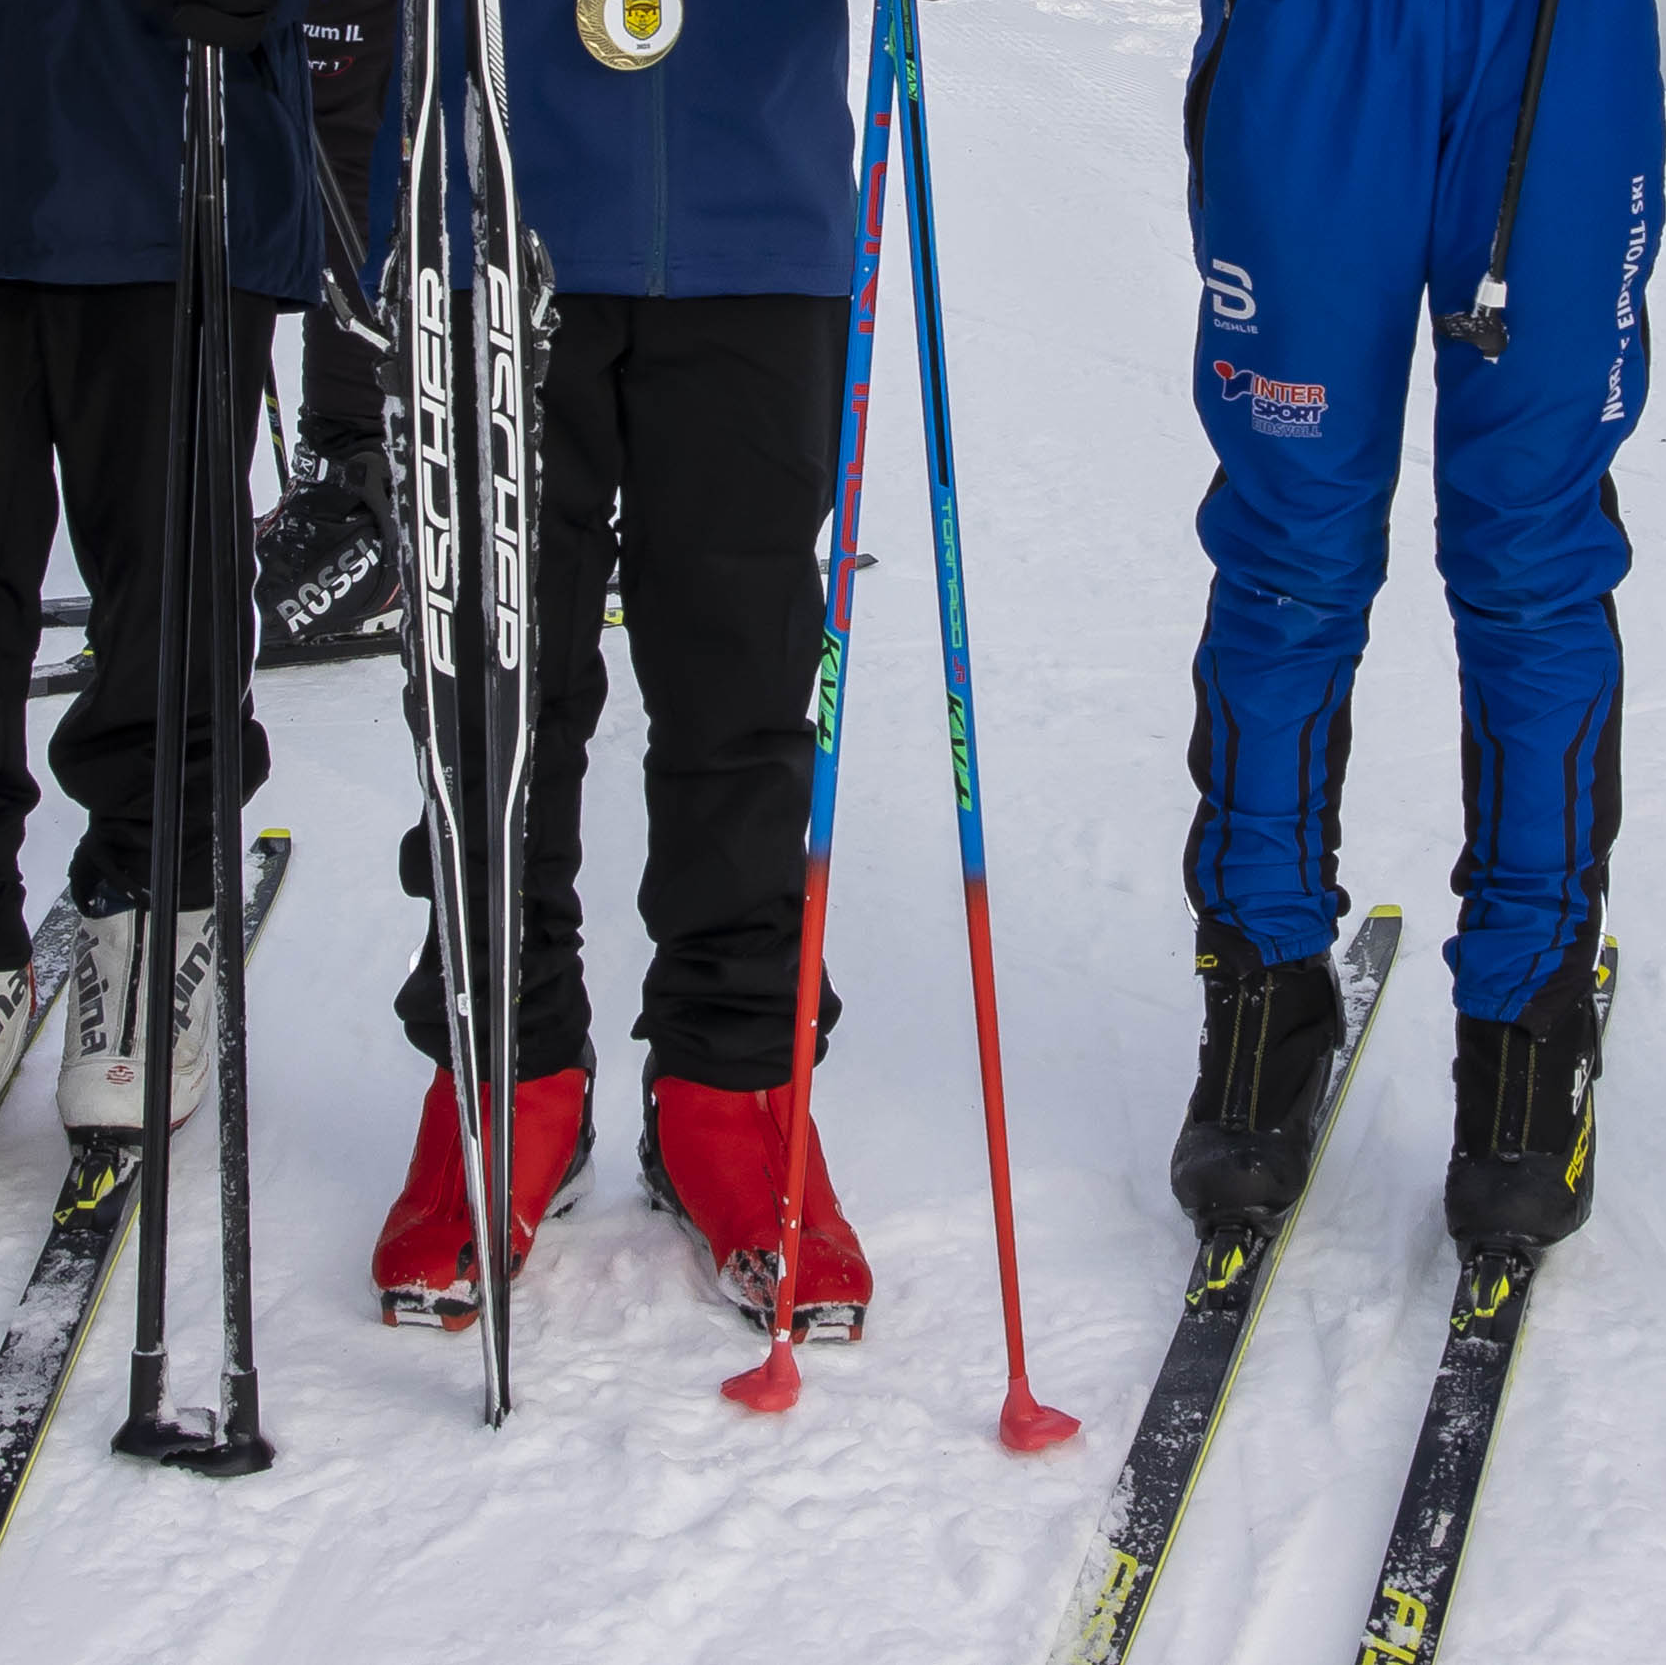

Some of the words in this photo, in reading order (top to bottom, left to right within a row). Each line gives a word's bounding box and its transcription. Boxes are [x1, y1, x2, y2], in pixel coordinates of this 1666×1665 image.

[302, 23, 340, 41] rum
[345, 24, 364, 42] IL
[1631, 175, 1645, 216] SKI
[1617, 220, 1647, 330] EIDVOLL
[1253, 375, 1325, 404] INTER
[1253, 396, 1328, 424] SPORT
[1252, 417, 1322, 438] EIDSVOLL
[419, 267, 457, 679] FISCHER
[487, 264, 520, 672] FISCHER
[941, 497, 962, 649] TORNADO
